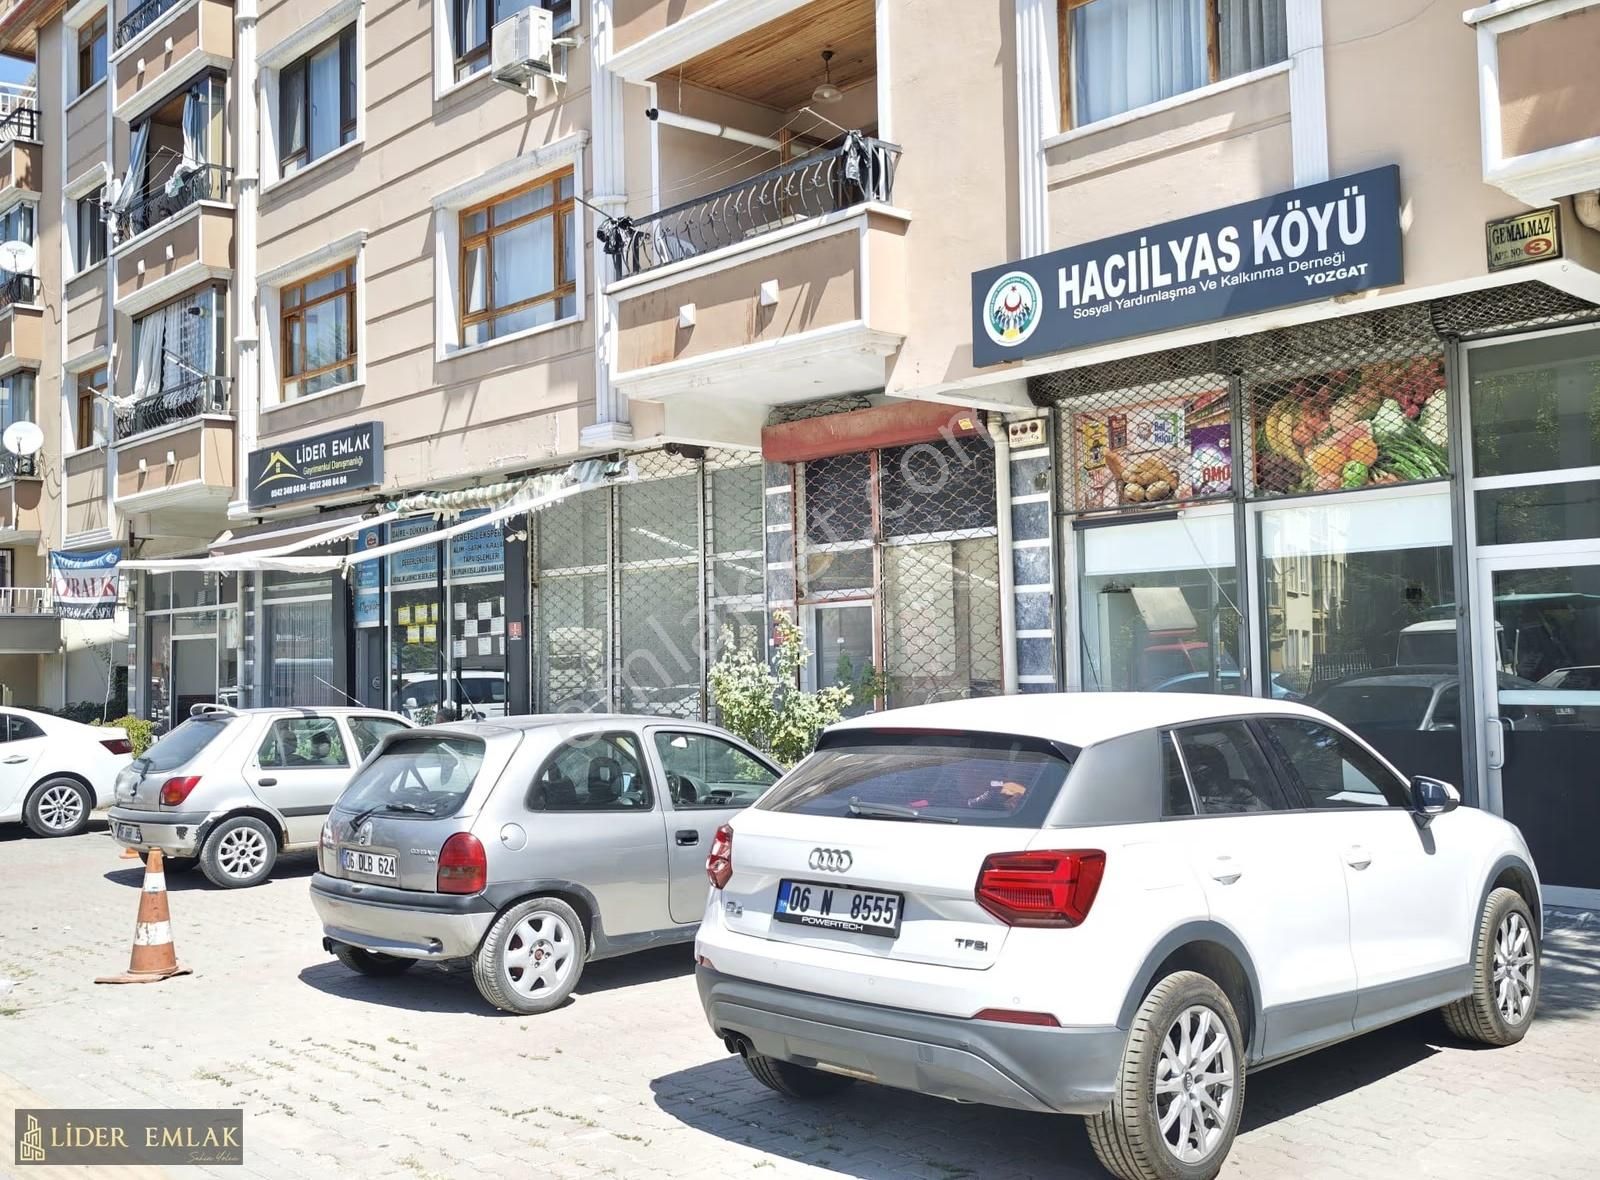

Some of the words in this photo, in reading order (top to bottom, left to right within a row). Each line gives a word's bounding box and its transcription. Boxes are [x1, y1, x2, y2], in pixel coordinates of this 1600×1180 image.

[1492, 216, 1551, 246] GEMALMAZ
[1058, 226, 1241, 309] HACIİLYAS
[1252, 185, 1367, 265] KÖYÜ
[1073, 302, 1112, 320] Sosyal
[1116, 284, 1197, 310] Yardımlaşma
[1200, 278, 1217, 292] Ve
[1220, 264, 1284, 288] Kalkınma
[1288, 250, 1346, 272] Derneği
[1304, 263, 1369, 286] YOZGAT
[296, 443, 327, 464] LİDER
[332, 433, 371, 457] EMLAK
[346, 850, 355, 869] 06
[358, 854, 373, 872] DLB
[378, 857, 395, 876] 624
[788, 885, 811, 913] 06
[820, 889, 834, 916] N
[850, 893, 896, 925] 8555
[801, 916, 863, 931] POWERTECH
